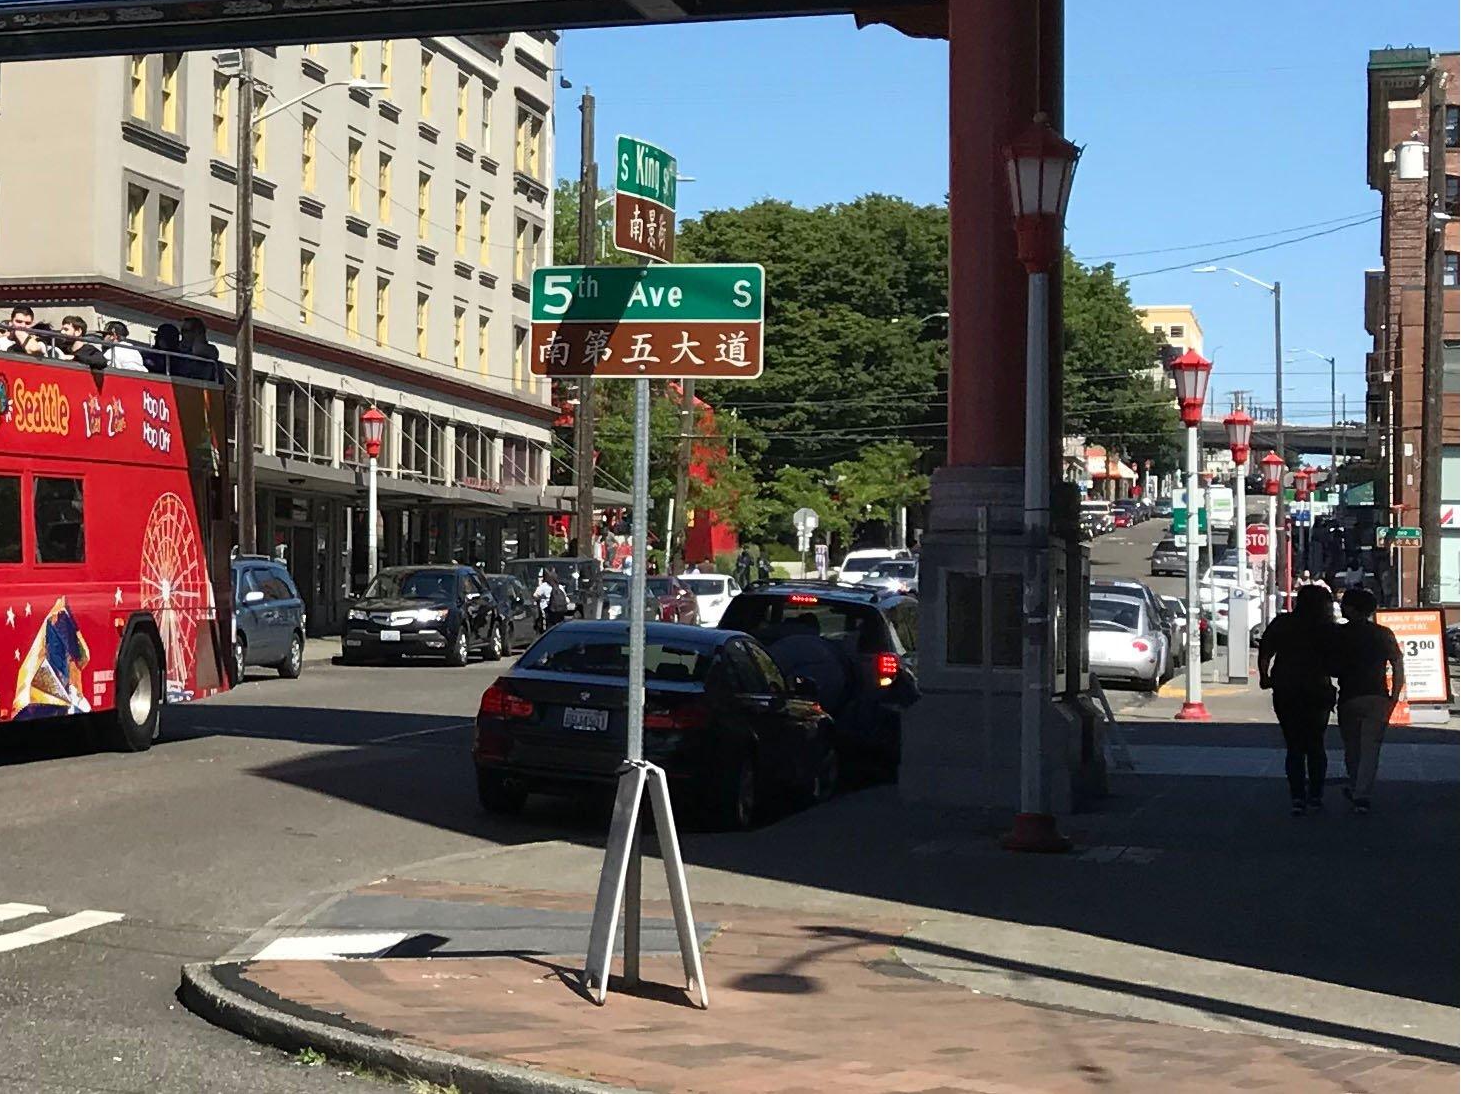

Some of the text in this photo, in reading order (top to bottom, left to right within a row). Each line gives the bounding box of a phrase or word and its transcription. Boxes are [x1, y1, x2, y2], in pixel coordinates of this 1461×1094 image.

[620, 152, 629, 182] S
[636, 144, 660, 198] King
[627, 281, 683, 308] Ave
[732, 279, 753, 308] S
[539, 330, 752, 368] 南第五大道
[13, 378, 71, 436] Seattle
[142, 390, 171, 423] Hop On
[142, 420, 158, 449] Hop
[159, 427, 172, 453] Off
